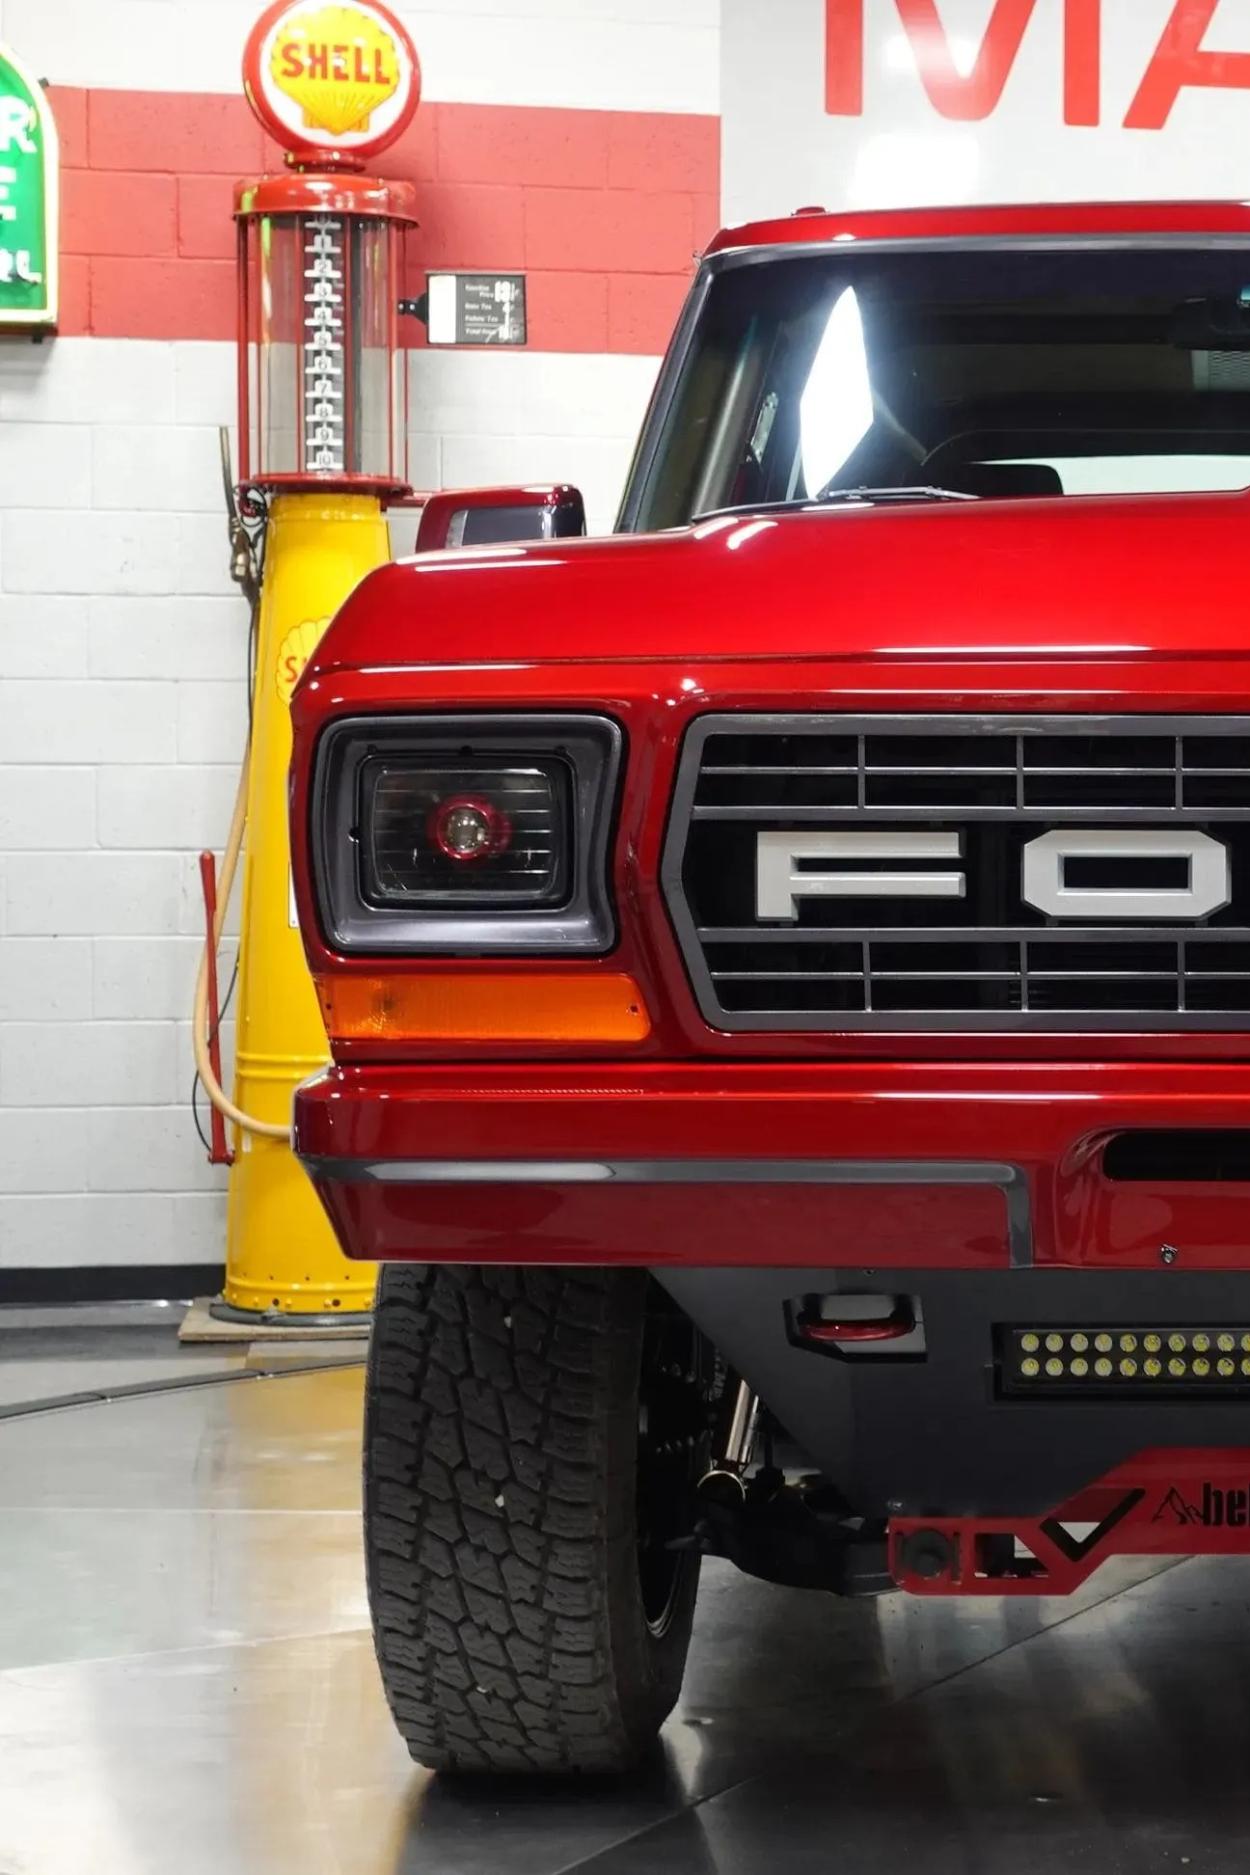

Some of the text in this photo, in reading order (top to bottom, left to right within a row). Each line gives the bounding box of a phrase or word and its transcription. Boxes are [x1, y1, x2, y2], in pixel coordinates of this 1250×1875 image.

[280, 43, 391, 85] SHELL
[319, 383, 328, 395] 7
[319, 407, 328, 418] 8
[320, 430, 329, 442] 9
[318, 454, 331, 466] 10
